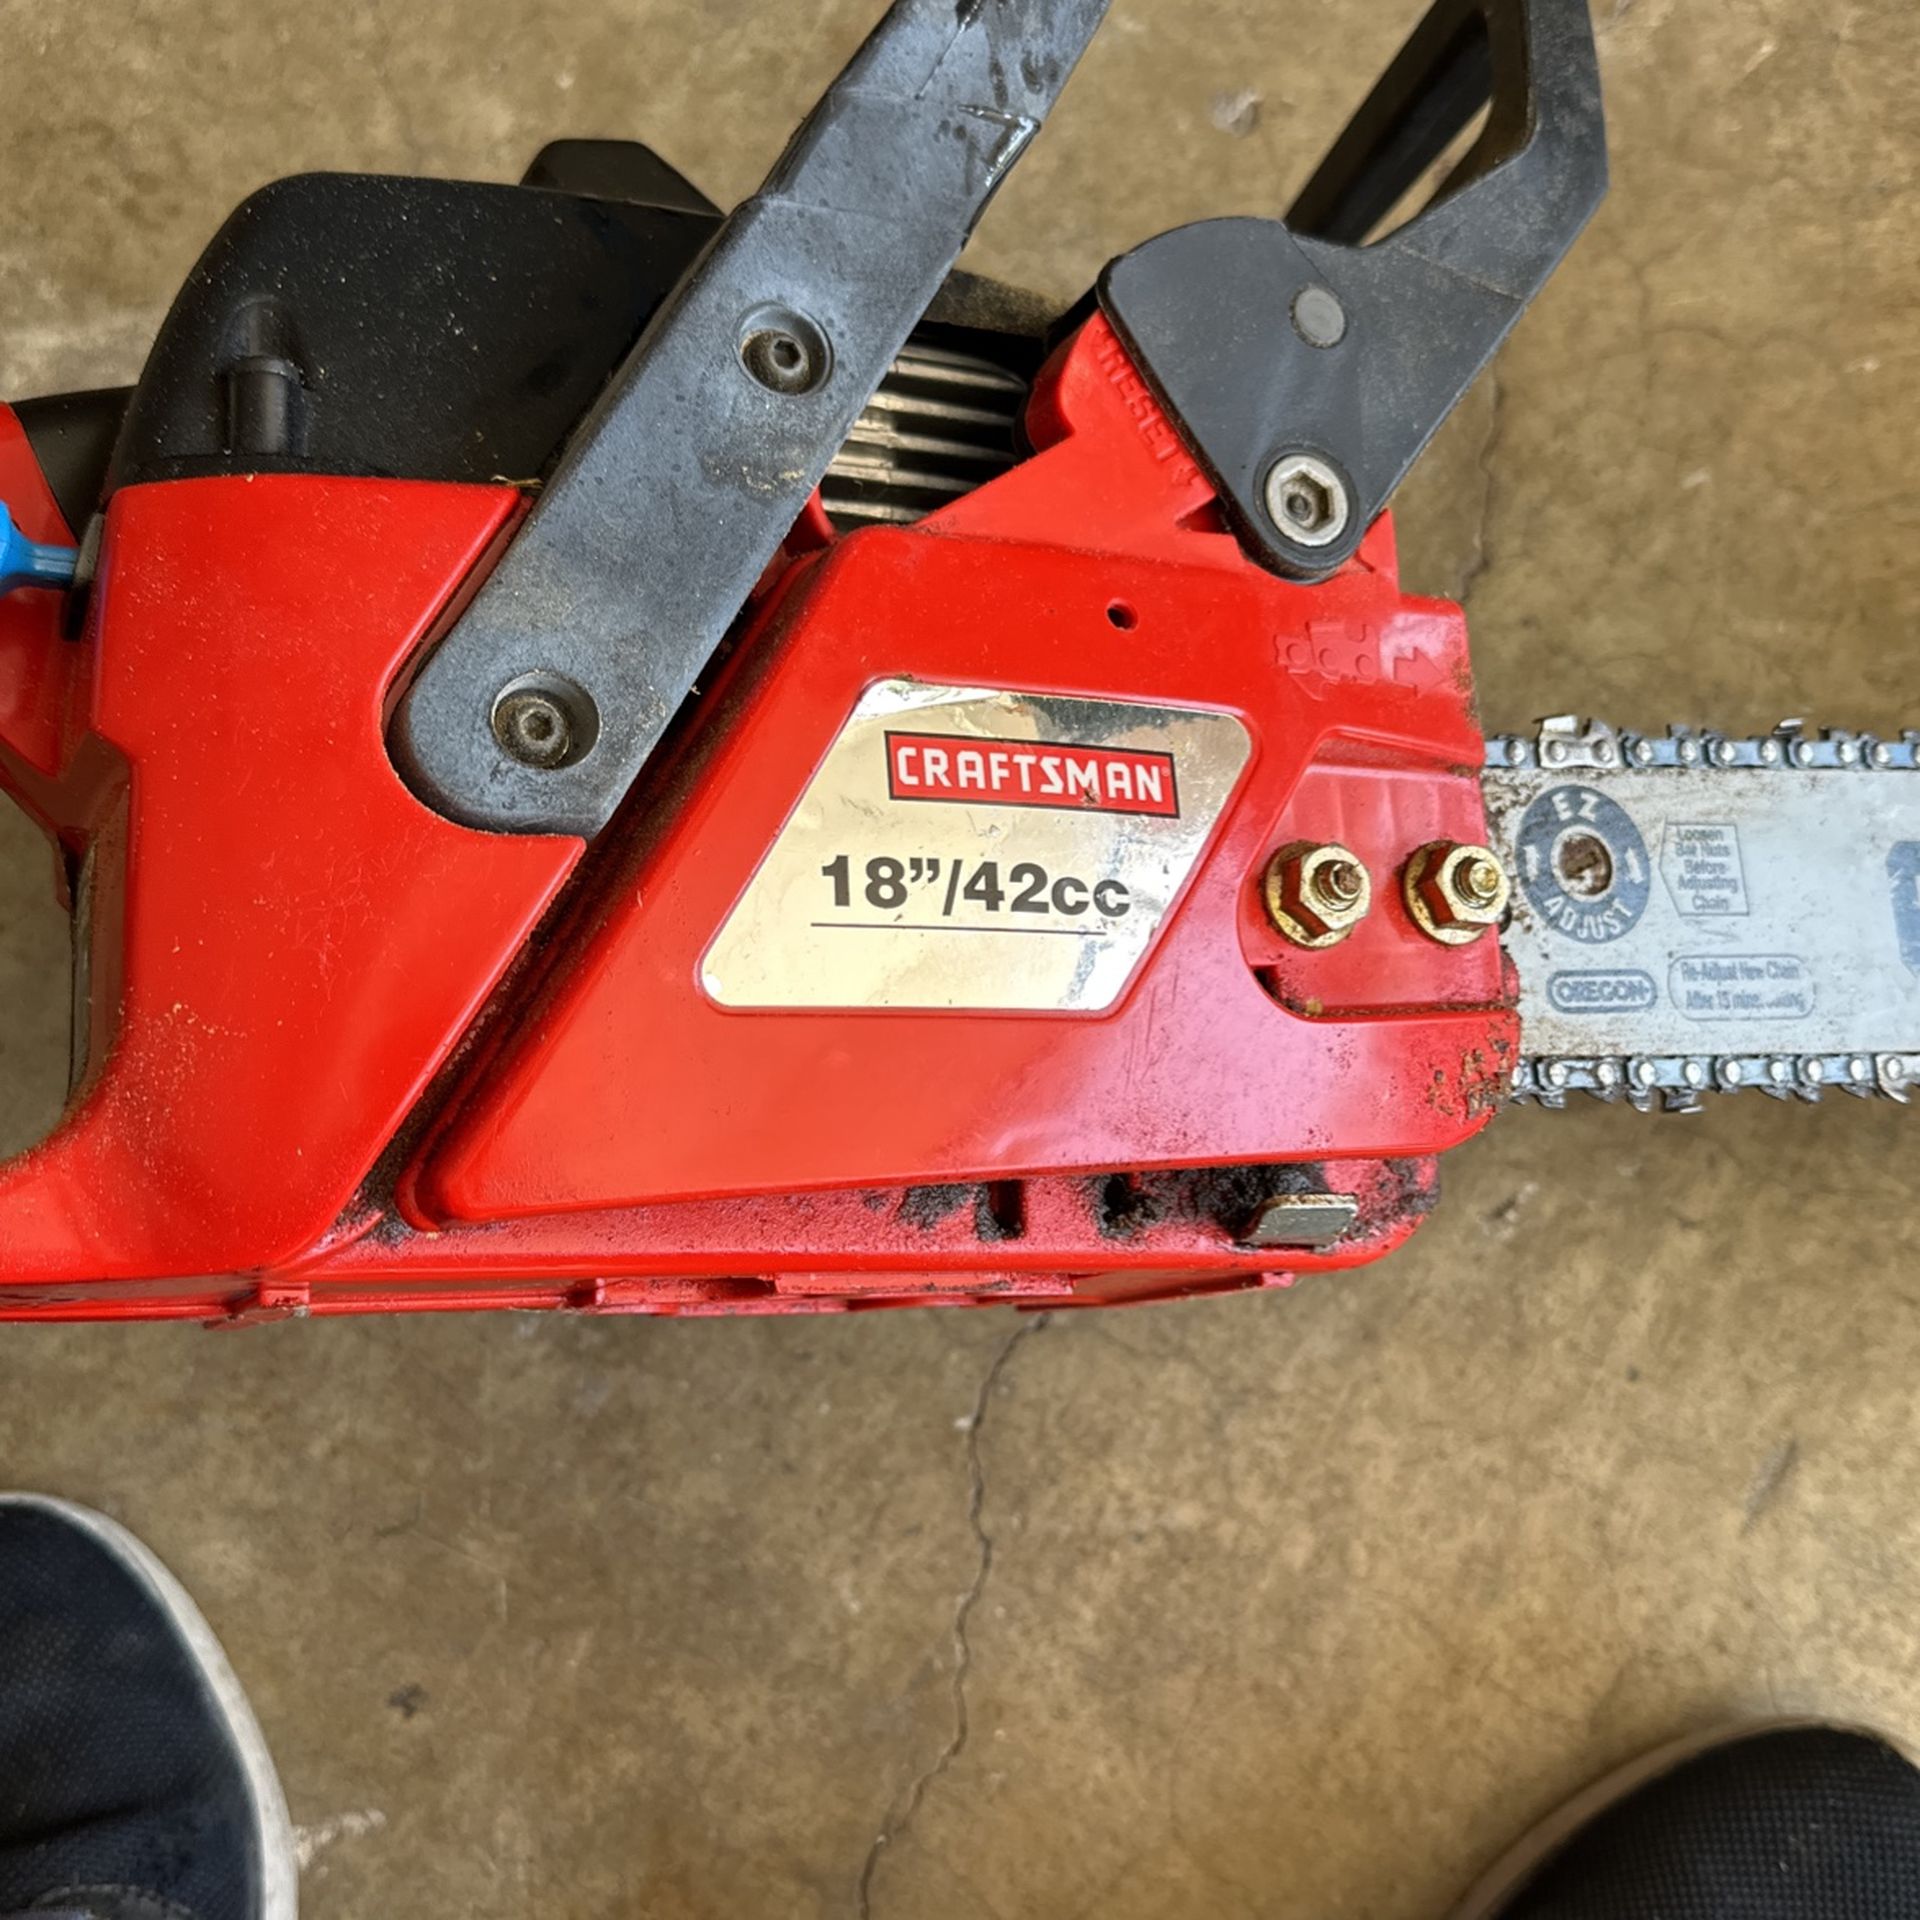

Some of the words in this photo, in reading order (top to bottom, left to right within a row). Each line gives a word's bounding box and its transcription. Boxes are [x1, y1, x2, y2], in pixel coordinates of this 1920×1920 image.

[1097, 346, 1182, 463] RESET
[896, 746, 1164, 802] CRAFTSMAN
[1551, 791, 1600, 822] EZ
[1543, 897, 1633, 940] ADJUST
